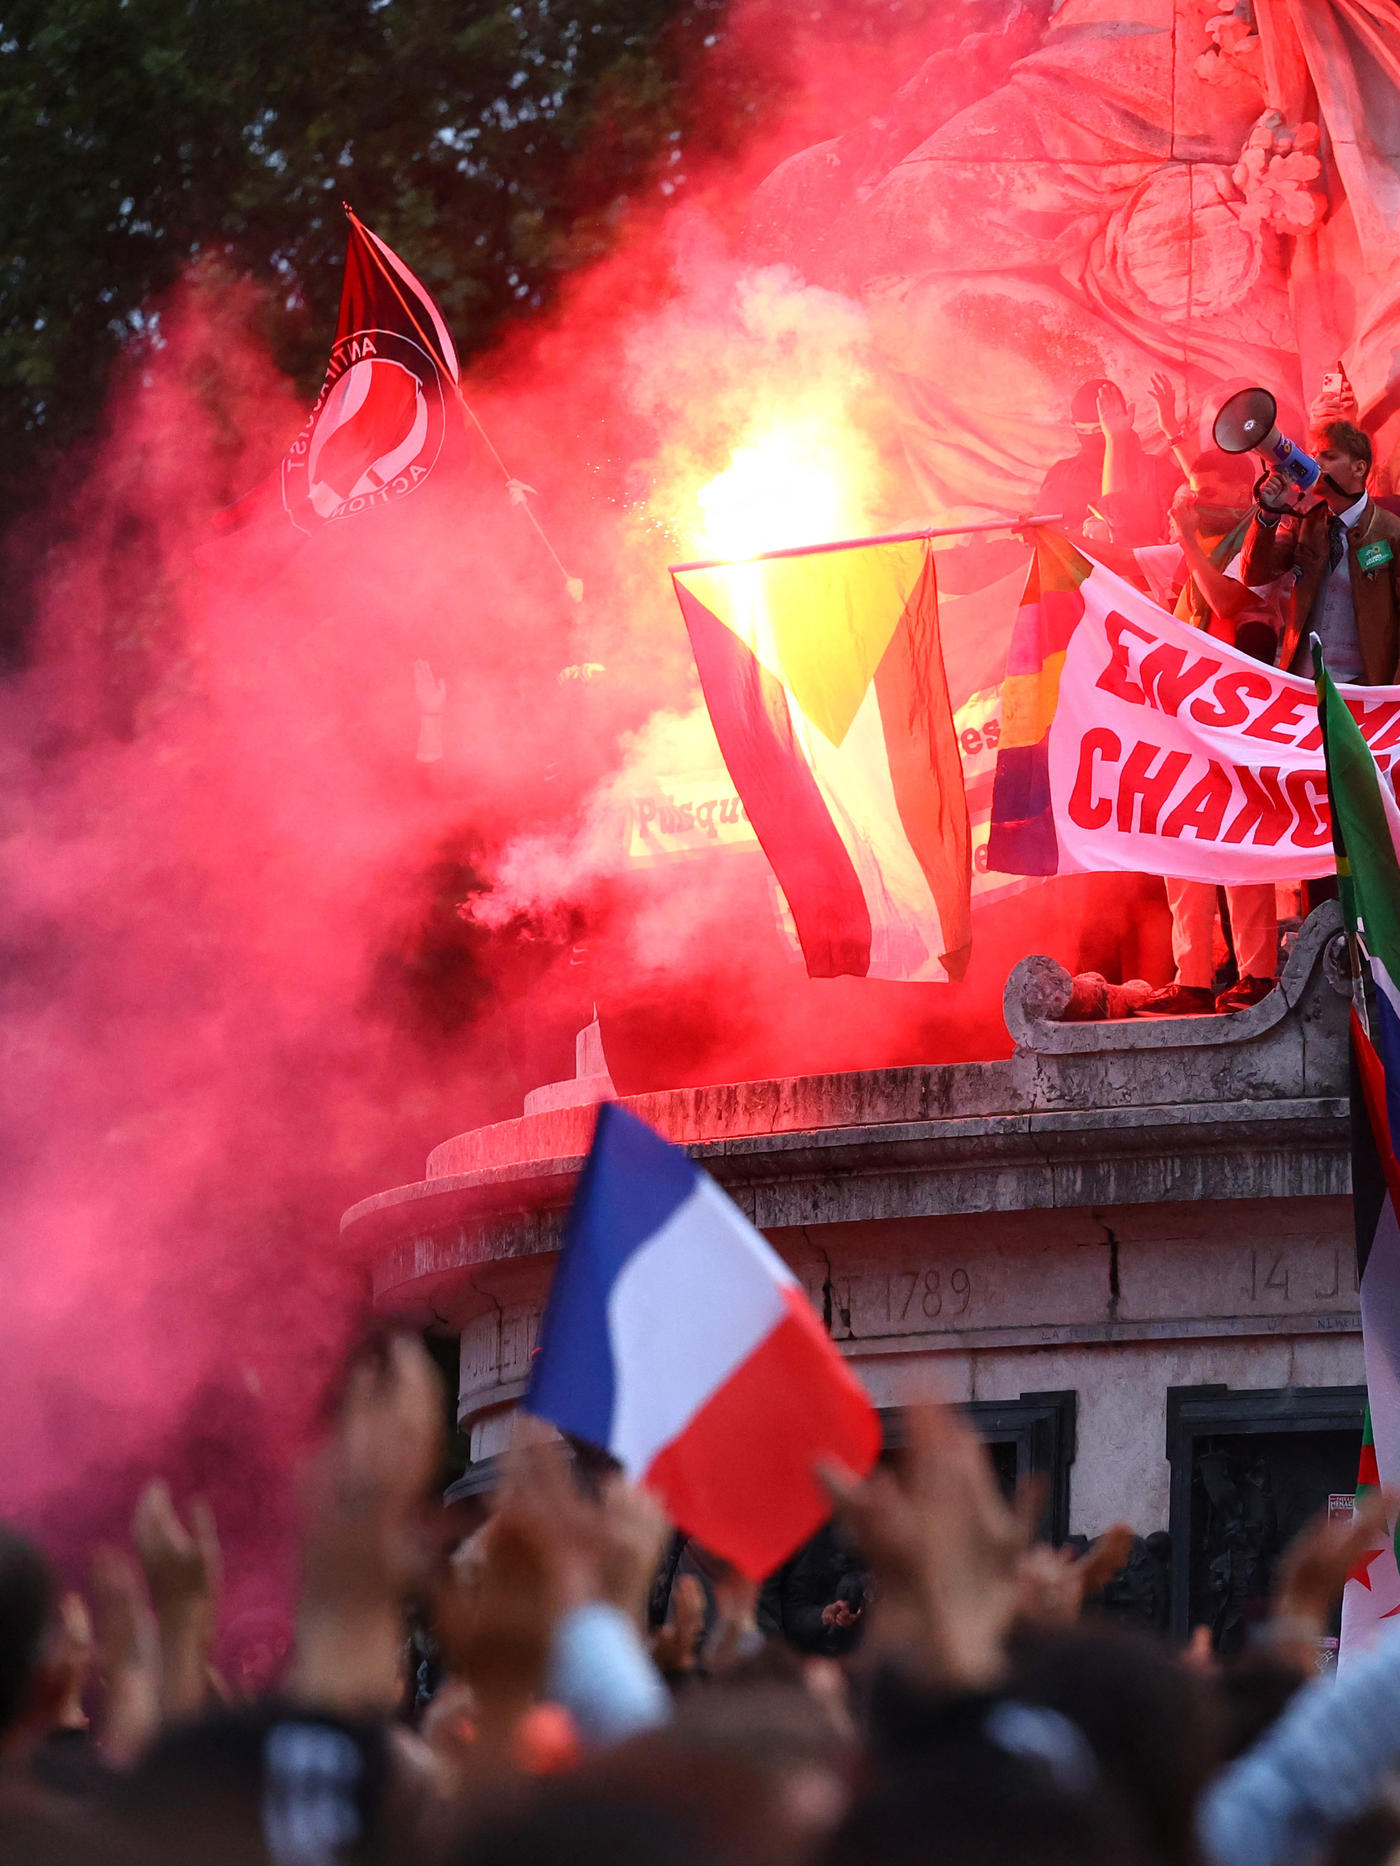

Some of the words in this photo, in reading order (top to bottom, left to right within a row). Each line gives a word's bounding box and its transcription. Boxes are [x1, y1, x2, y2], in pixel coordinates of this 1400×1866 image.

[961, 719, 1000, 755] es
[885, 1267, 971, 1322] 1789
[1250, 1249, 1290, 1301] 14
